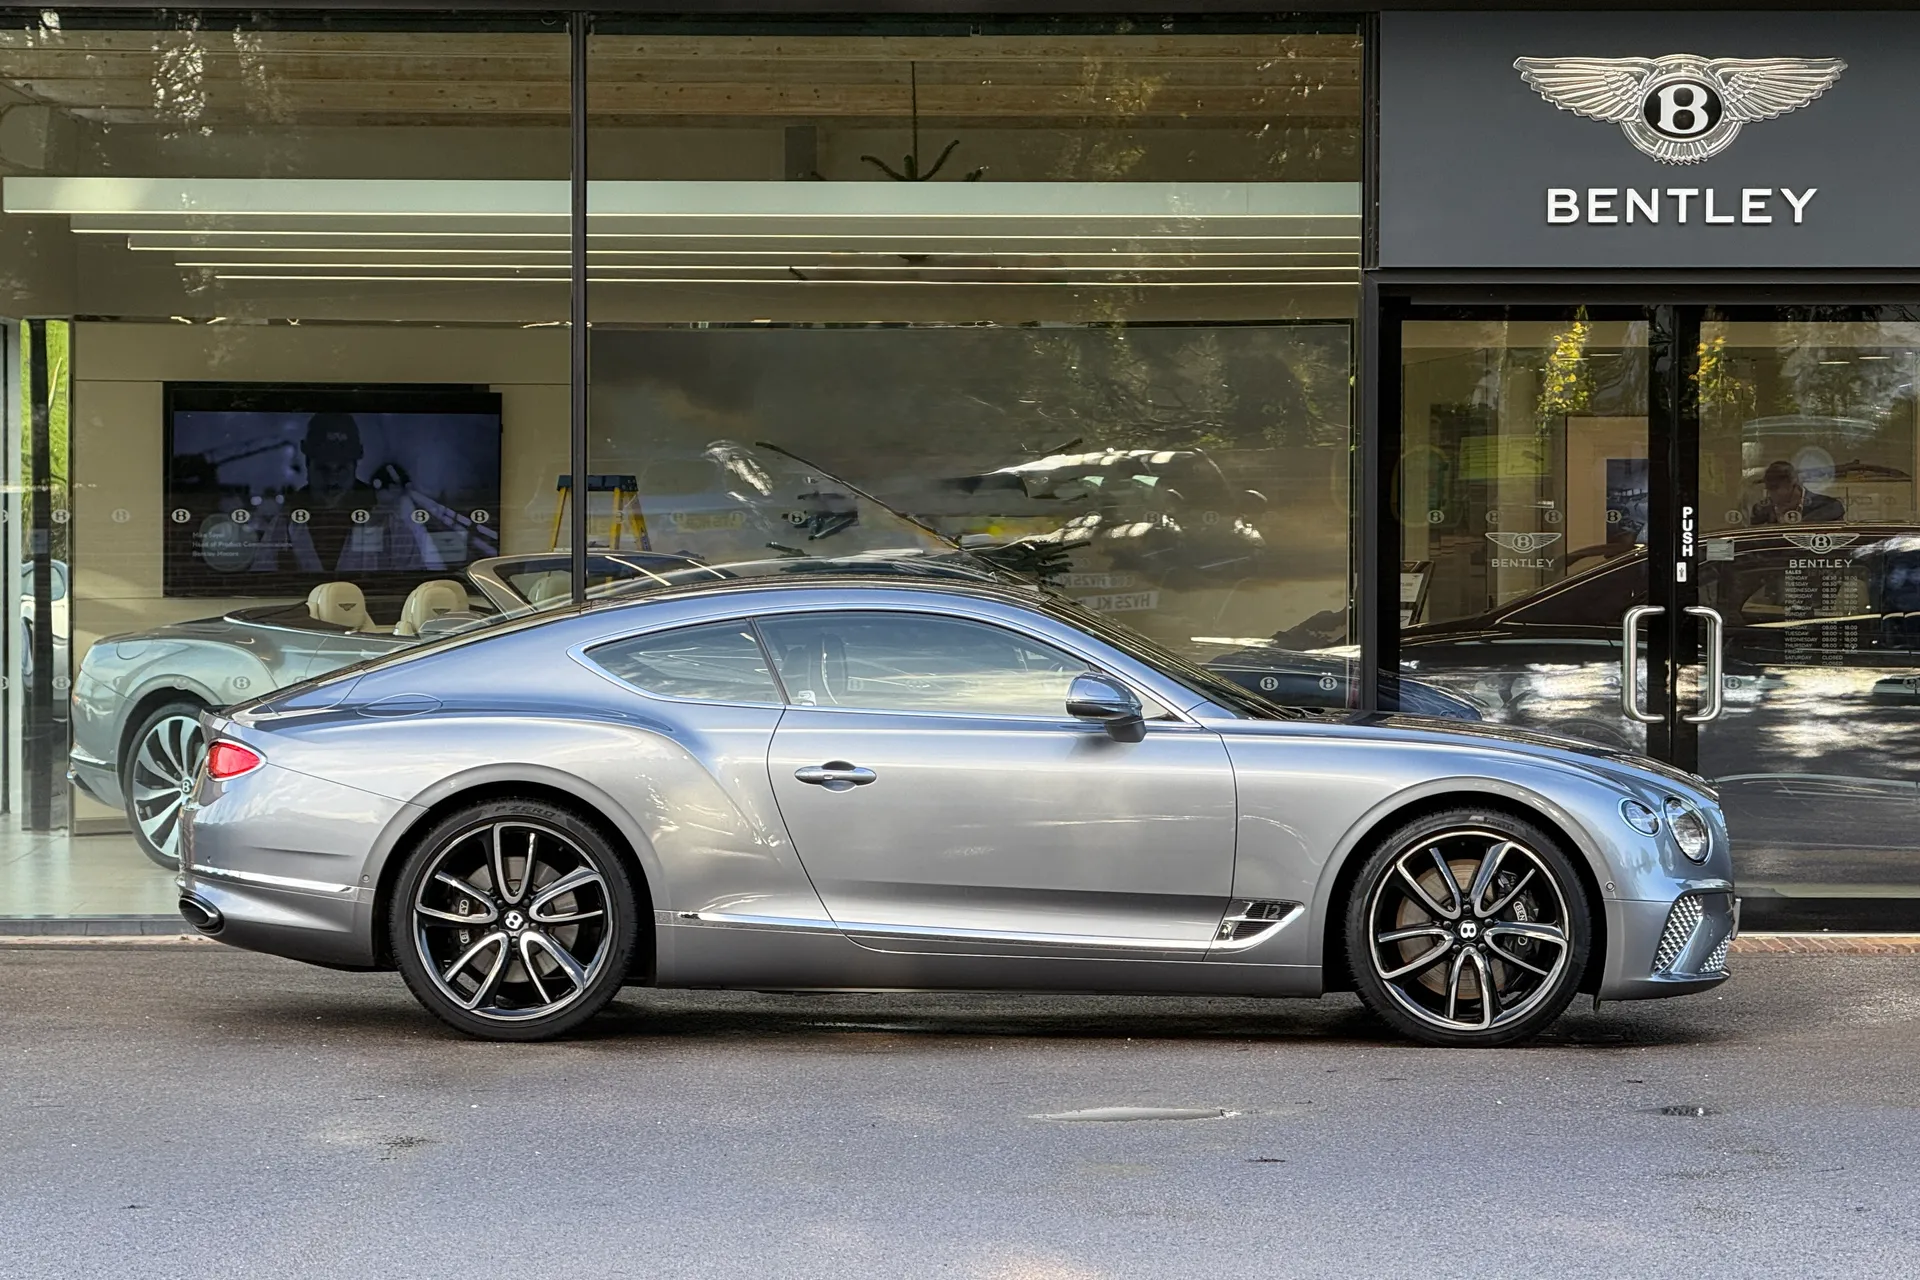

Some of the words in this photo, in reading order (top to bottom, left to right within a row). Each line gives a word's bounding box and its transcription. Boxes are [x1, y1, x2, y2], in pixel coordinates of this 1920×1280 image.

[1657, 84, 1709, 134] B
[1546, 187, 1818, 224] BENTLEY
[1682, 507, 1694, 557] PUSH
[1519, 536, 1530, 547] B
[1817, 536, 1828, 547] B
[1491, 558, 1555, 568] BENTLEY
[1789, 559, 1853, 568] BENTLEY
[1262, 904, 1281, 919] 12
[505, 912, 523, 929] B
[1460, 922, 1477, 939] B
